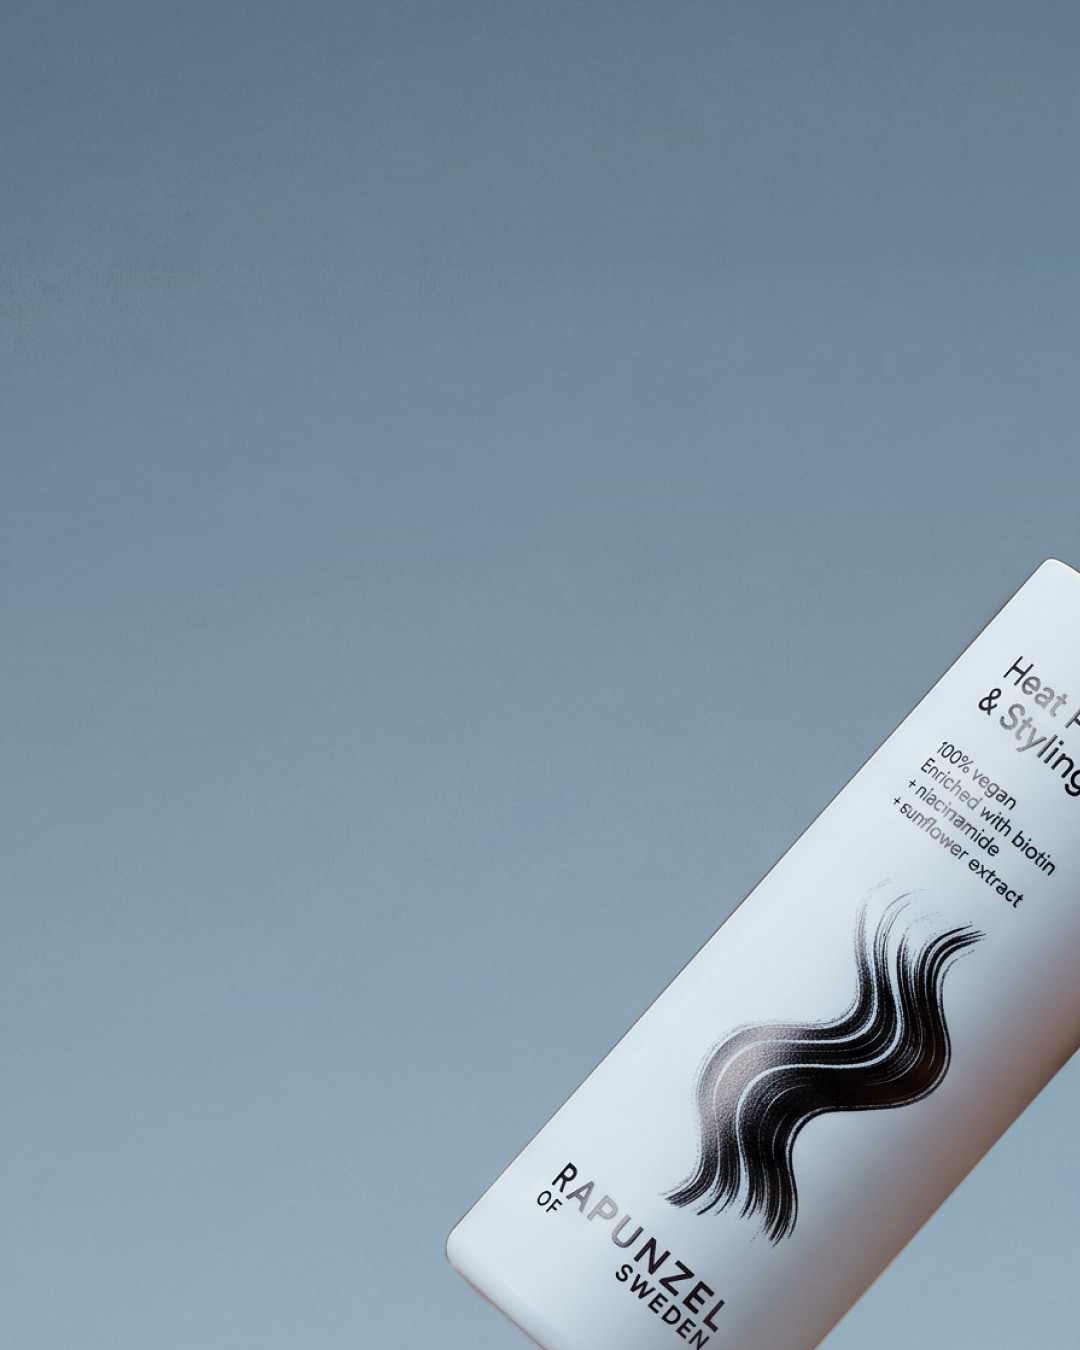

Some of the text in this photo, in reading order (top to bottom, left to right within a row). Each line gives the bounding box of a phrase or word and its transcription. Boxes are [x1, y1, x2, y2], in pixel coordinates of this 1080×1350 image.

[978, 688, 1002, 715] &
[1002, 655, 1069, 718] Heat
[916, 783, 1000, 857] niacinamide
[920, 758, 1056, 876] Enriched with biotin
[936, 741, 1017, 810] 100% vegan
[900, 804, 968, 862] sunflower
[967, 857, 1024, 908] extract
[536, 1190, 710, 1350] OF SWEDEN
[551, 1162, 725, 1332] RAPUNZEL
